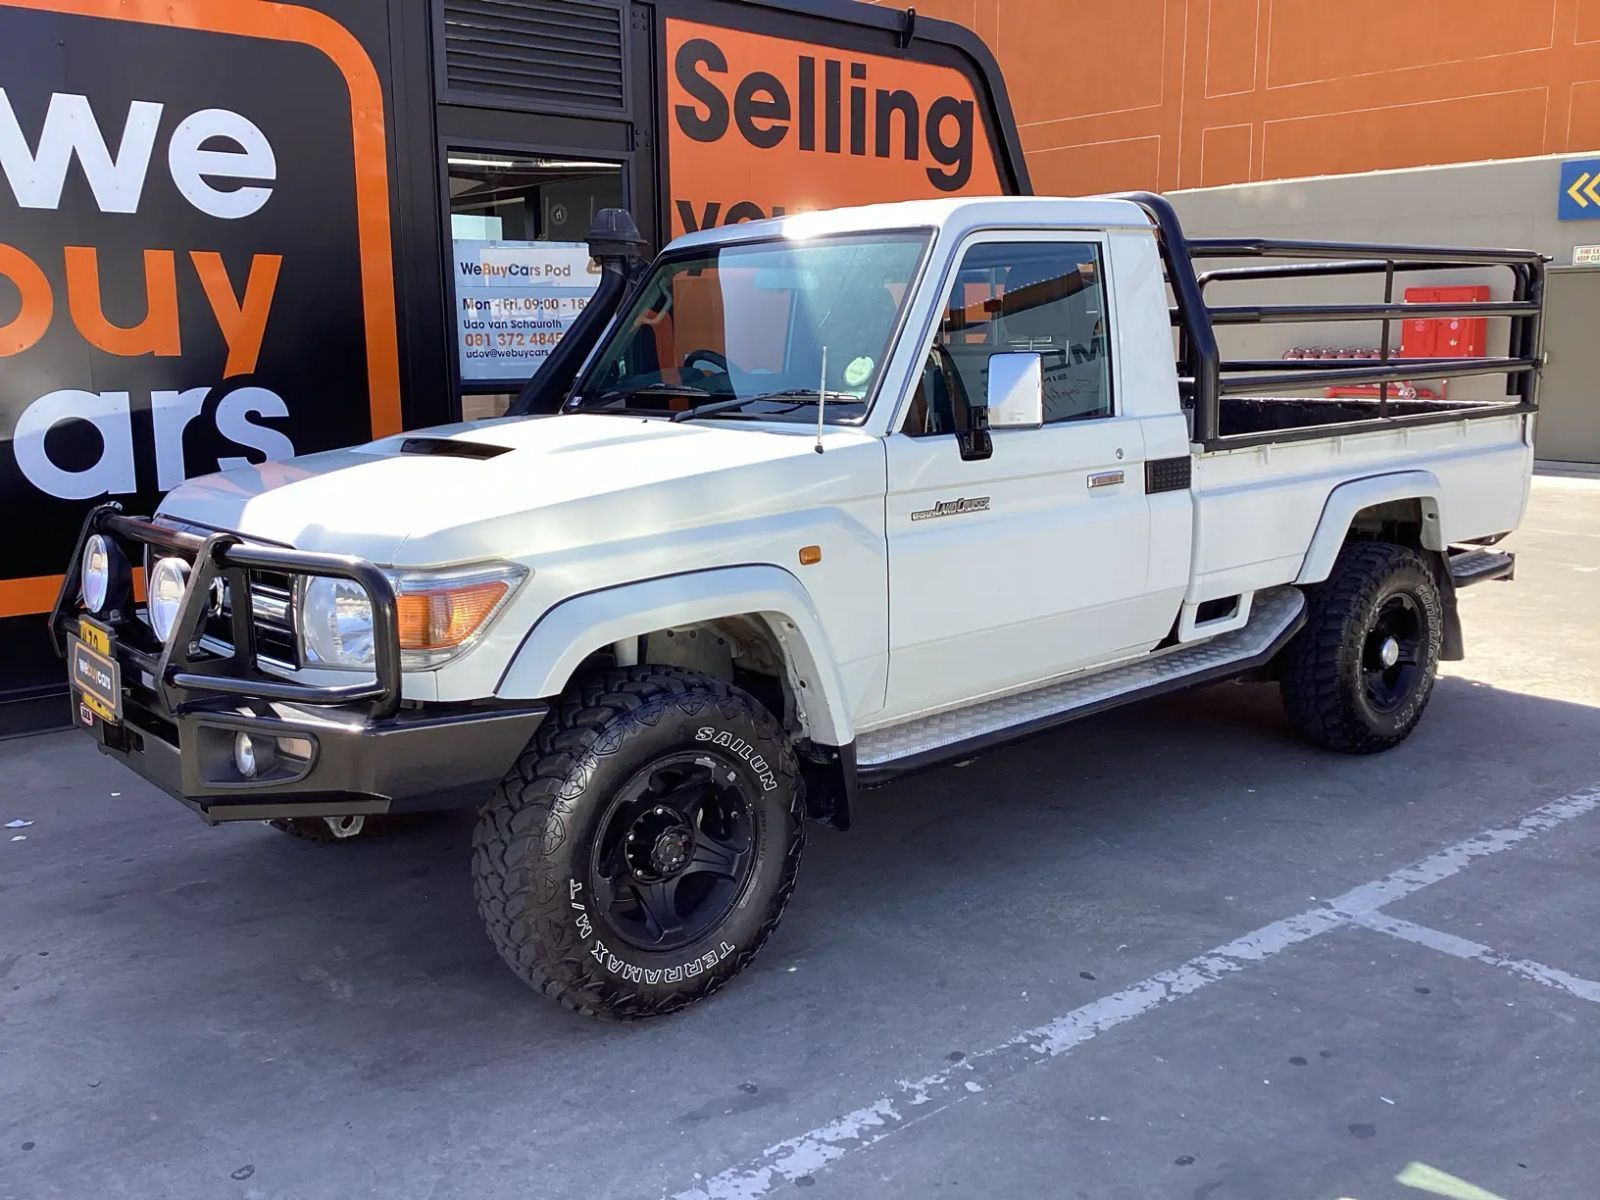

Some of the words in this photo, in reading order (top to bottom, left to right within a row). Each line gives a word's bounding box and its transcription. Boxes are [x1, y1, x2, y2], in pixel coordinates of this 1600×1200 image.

[675, 38, 974, 191] Selling
[0, 87, 277, 219] we
[460, 262, 541, 278] WeBuyCars
[544, 264, 571, 277] Pod
[463, 298, 491, 311] Mon
[524, 299, 559, 310] 09:00
[488, 321, 508, 329] van
[465, 333, 491, 347] 081
[497, 333, 525, 346] 372
[466, 349, 551, 360] udov@webuycars.
[13, 387, 295, 500] ars
[695, 726, 778, 791] SAILUN
[569, 878, 593, 939] M/T
[591, 940, 736, 985] TERRAMAX
